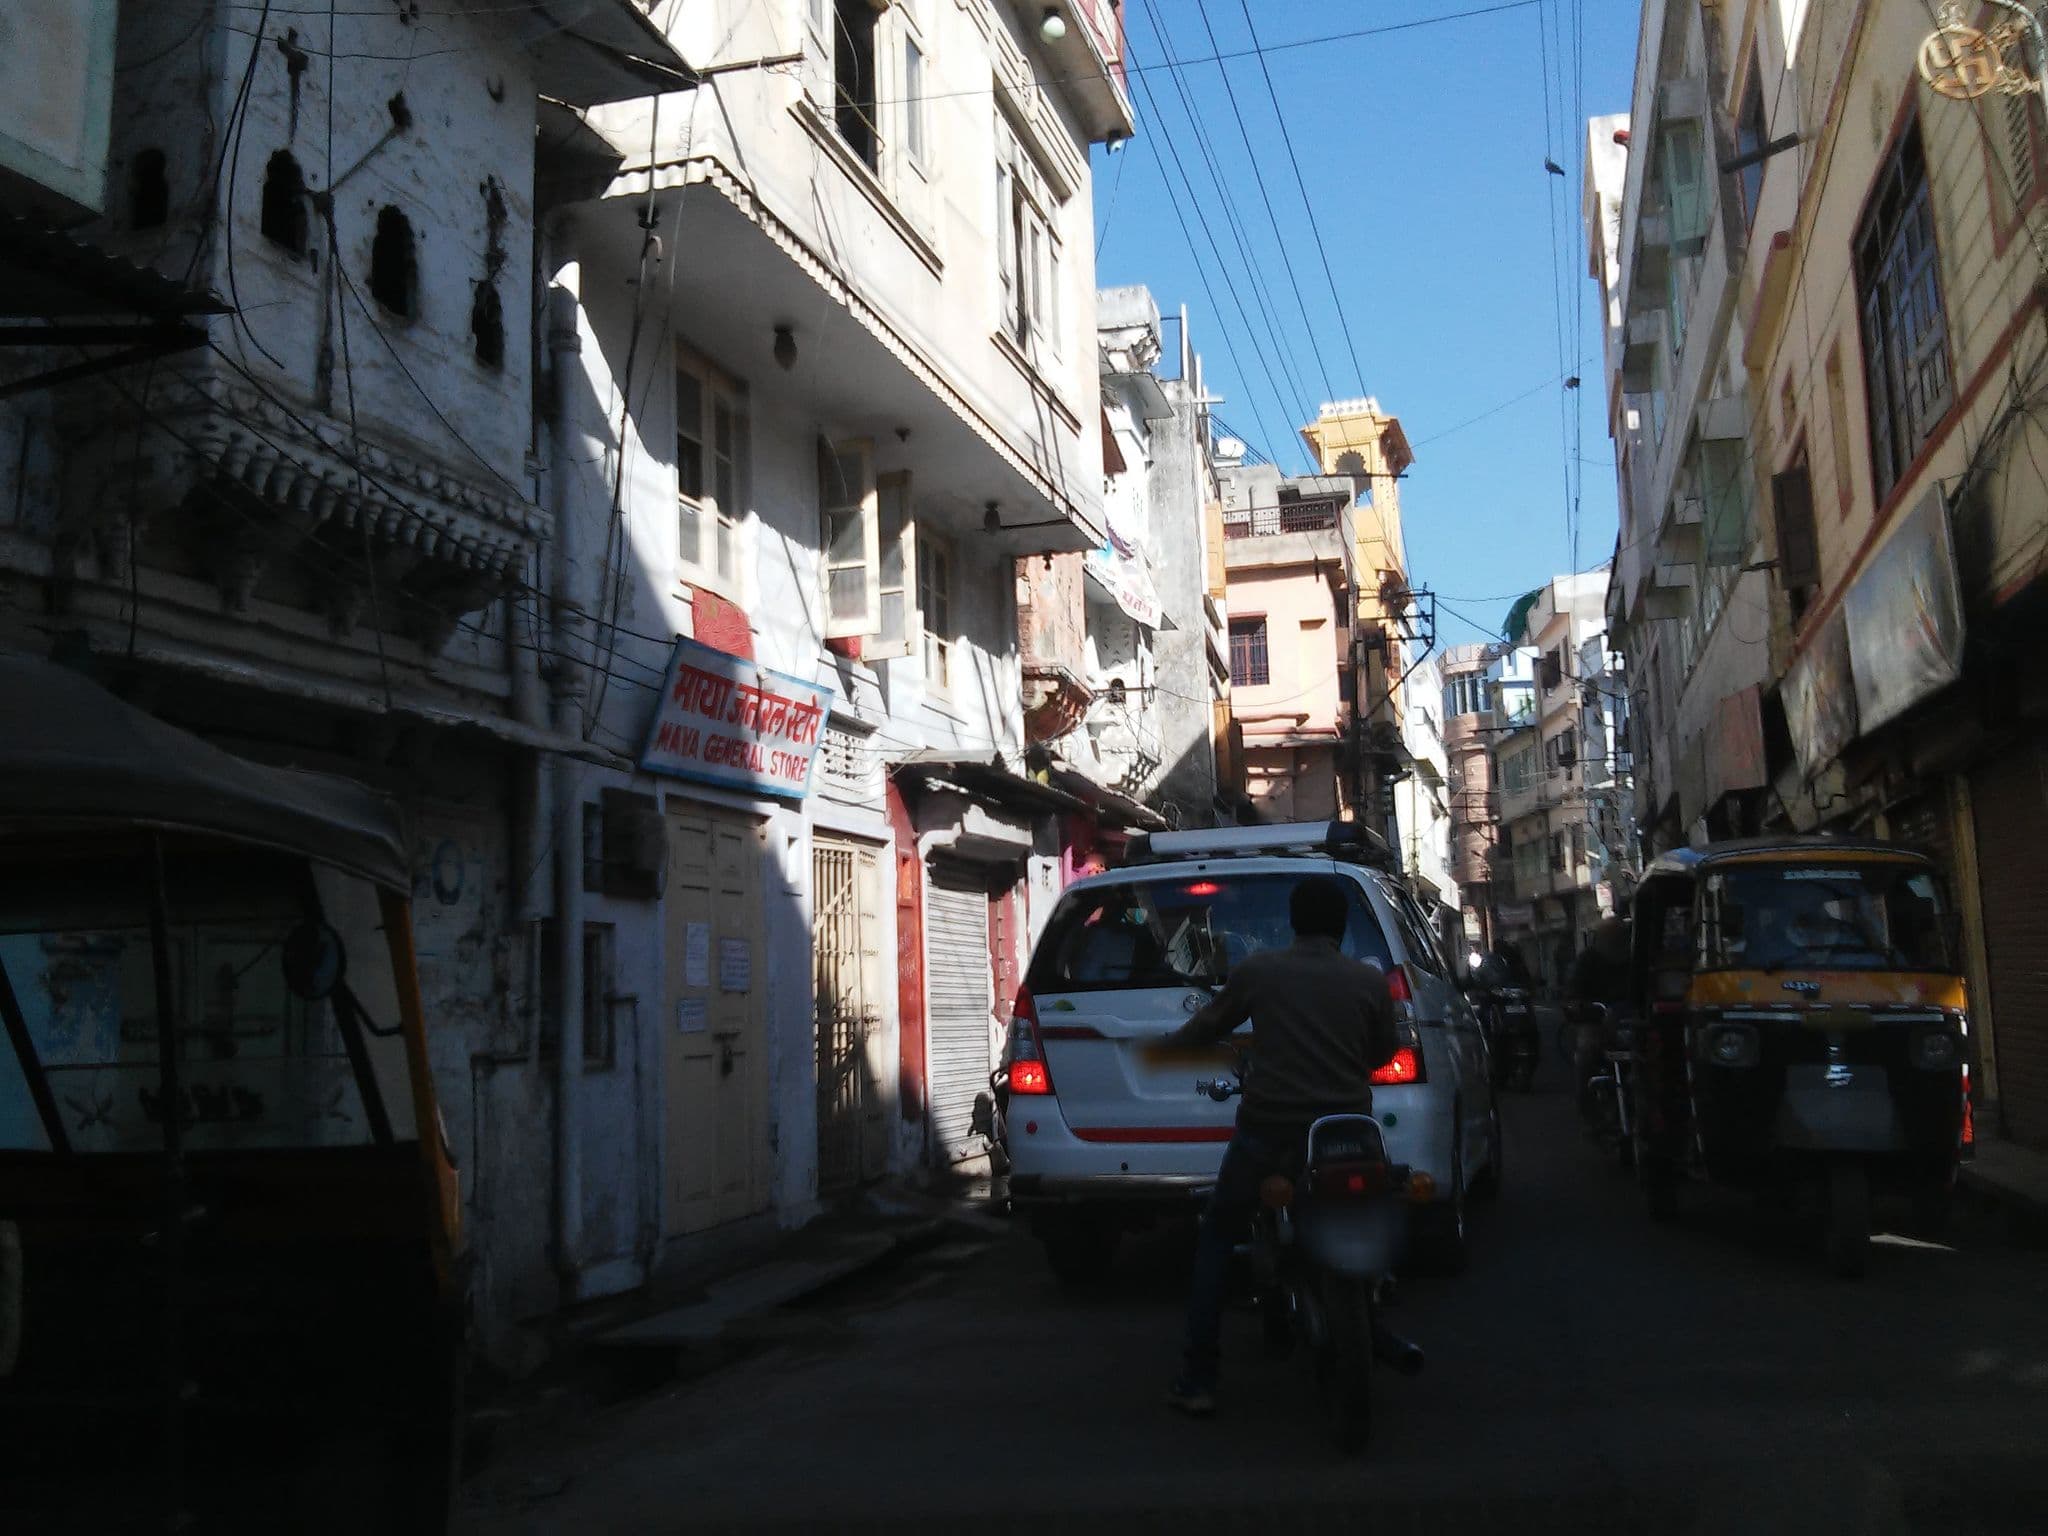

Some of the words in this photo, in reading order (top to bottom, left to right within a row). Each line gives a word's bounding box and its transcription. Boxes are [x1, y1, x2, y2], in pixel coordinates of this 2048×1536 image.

[673, 664, 735, 720] माया
[727, 683, 793, 736] जनरल
[656, 720, 700, 759] MAYA
[704, 734, 765, 773] GENERAL
[770, 751, 809, 782] STORE
